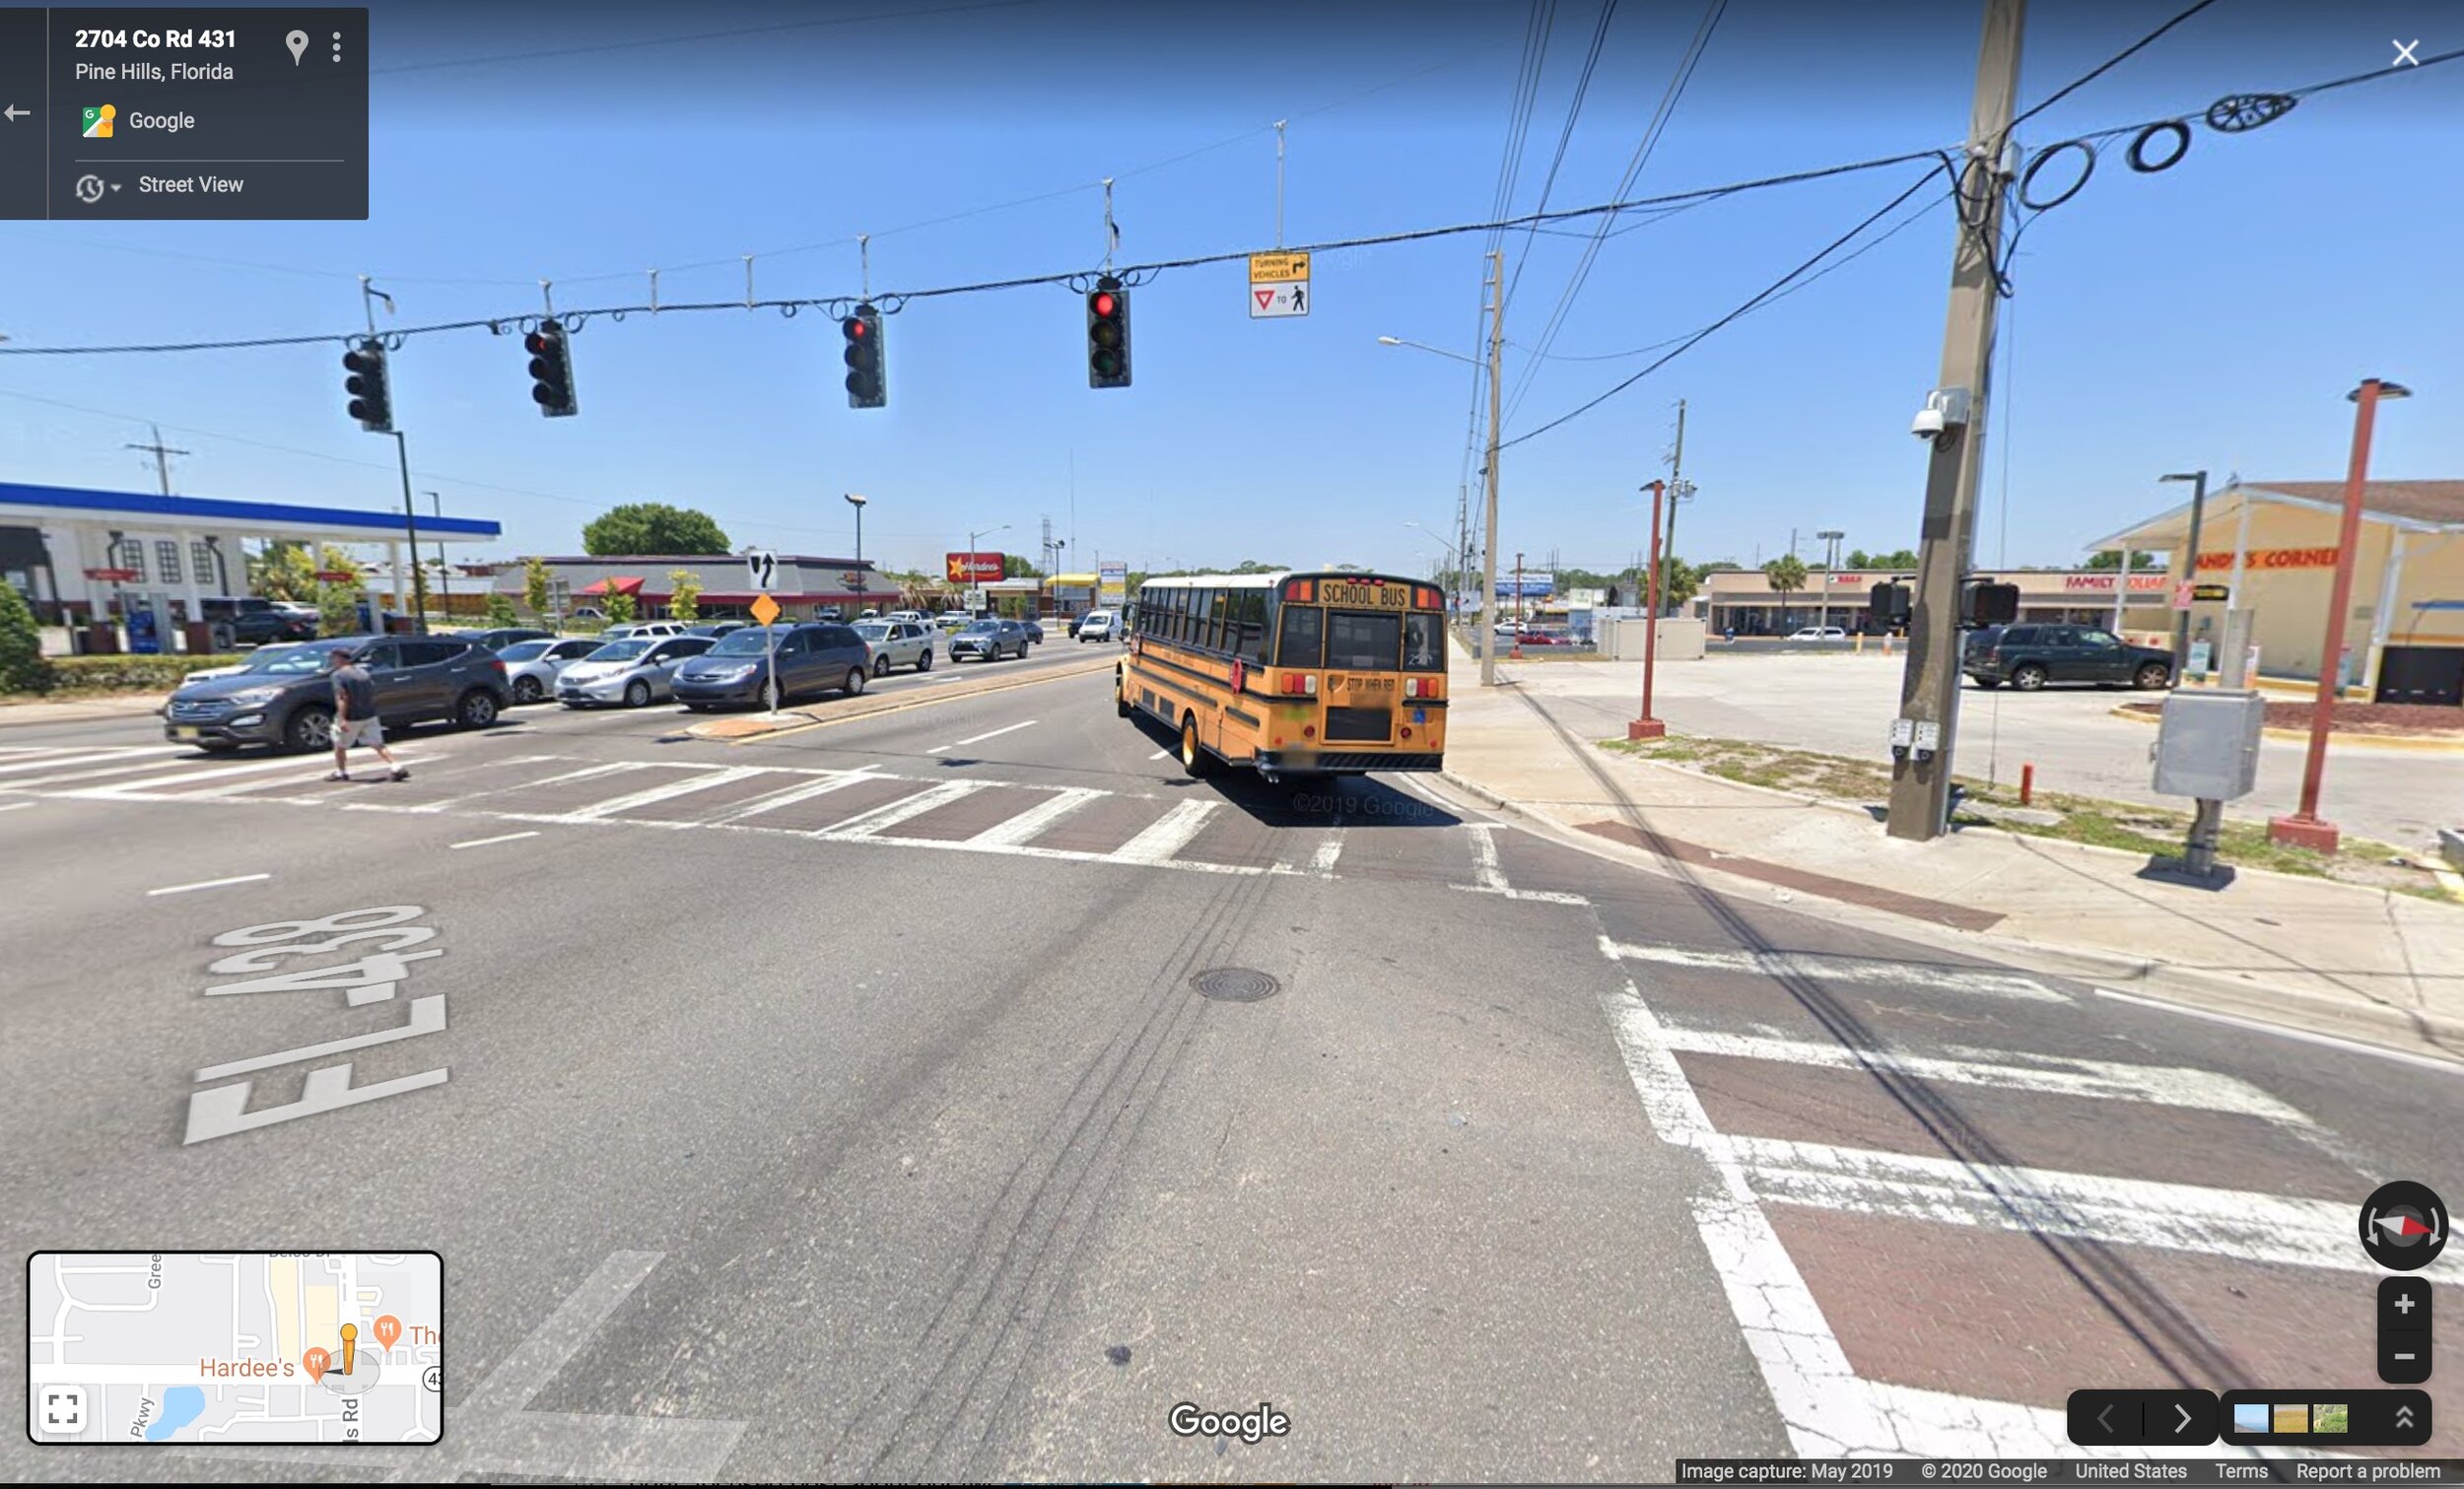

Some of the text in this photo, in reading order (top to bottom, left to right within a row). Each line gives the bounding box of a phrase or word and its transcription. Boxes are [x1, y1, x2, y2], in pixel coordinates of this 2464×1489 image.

[1254, 270, 1290, 279] VEHICLES
[1277, 296, 1287, 305] TO
[1323, 583, 1406, 606] SCHOOL BUS
